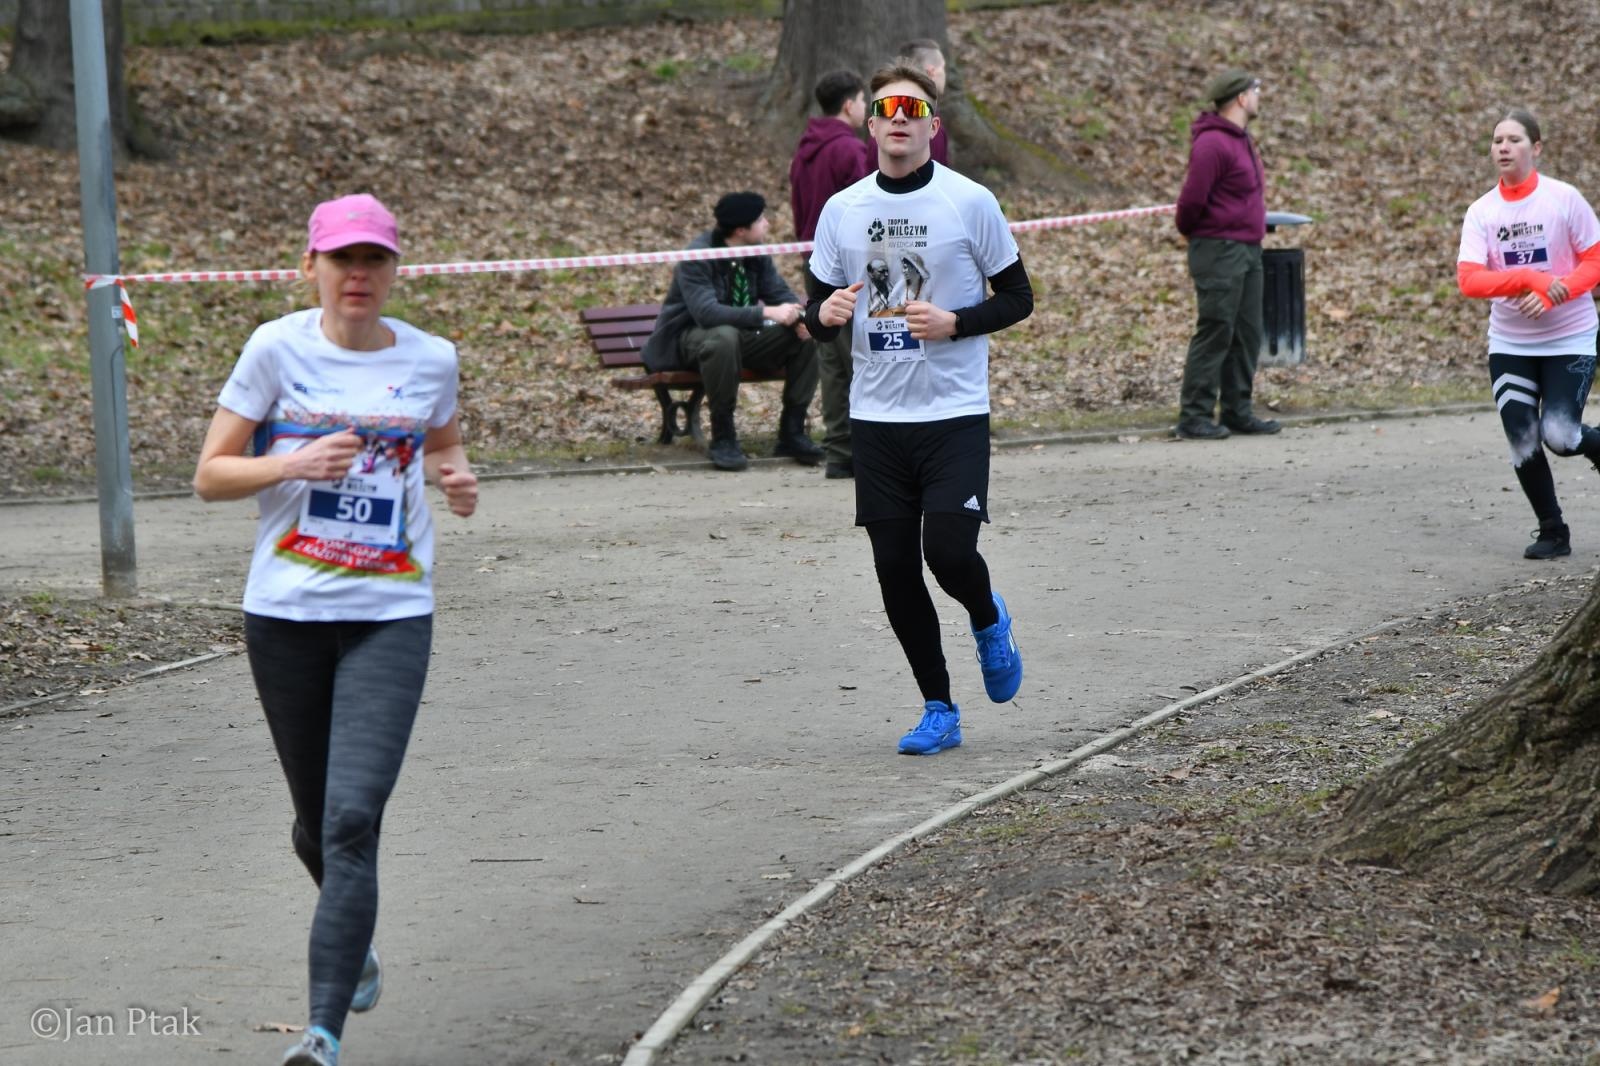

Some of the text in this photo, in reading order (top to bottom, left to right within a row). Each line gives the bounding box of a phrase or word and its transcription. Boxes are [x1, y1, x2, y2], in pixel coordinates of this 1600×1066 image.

[888, 225, 928, 236] WILCZYM
[1516, 250, 1534, 265] 37
[882, 332, 904, 350] 25
[336, 496, 372, 523] 50
